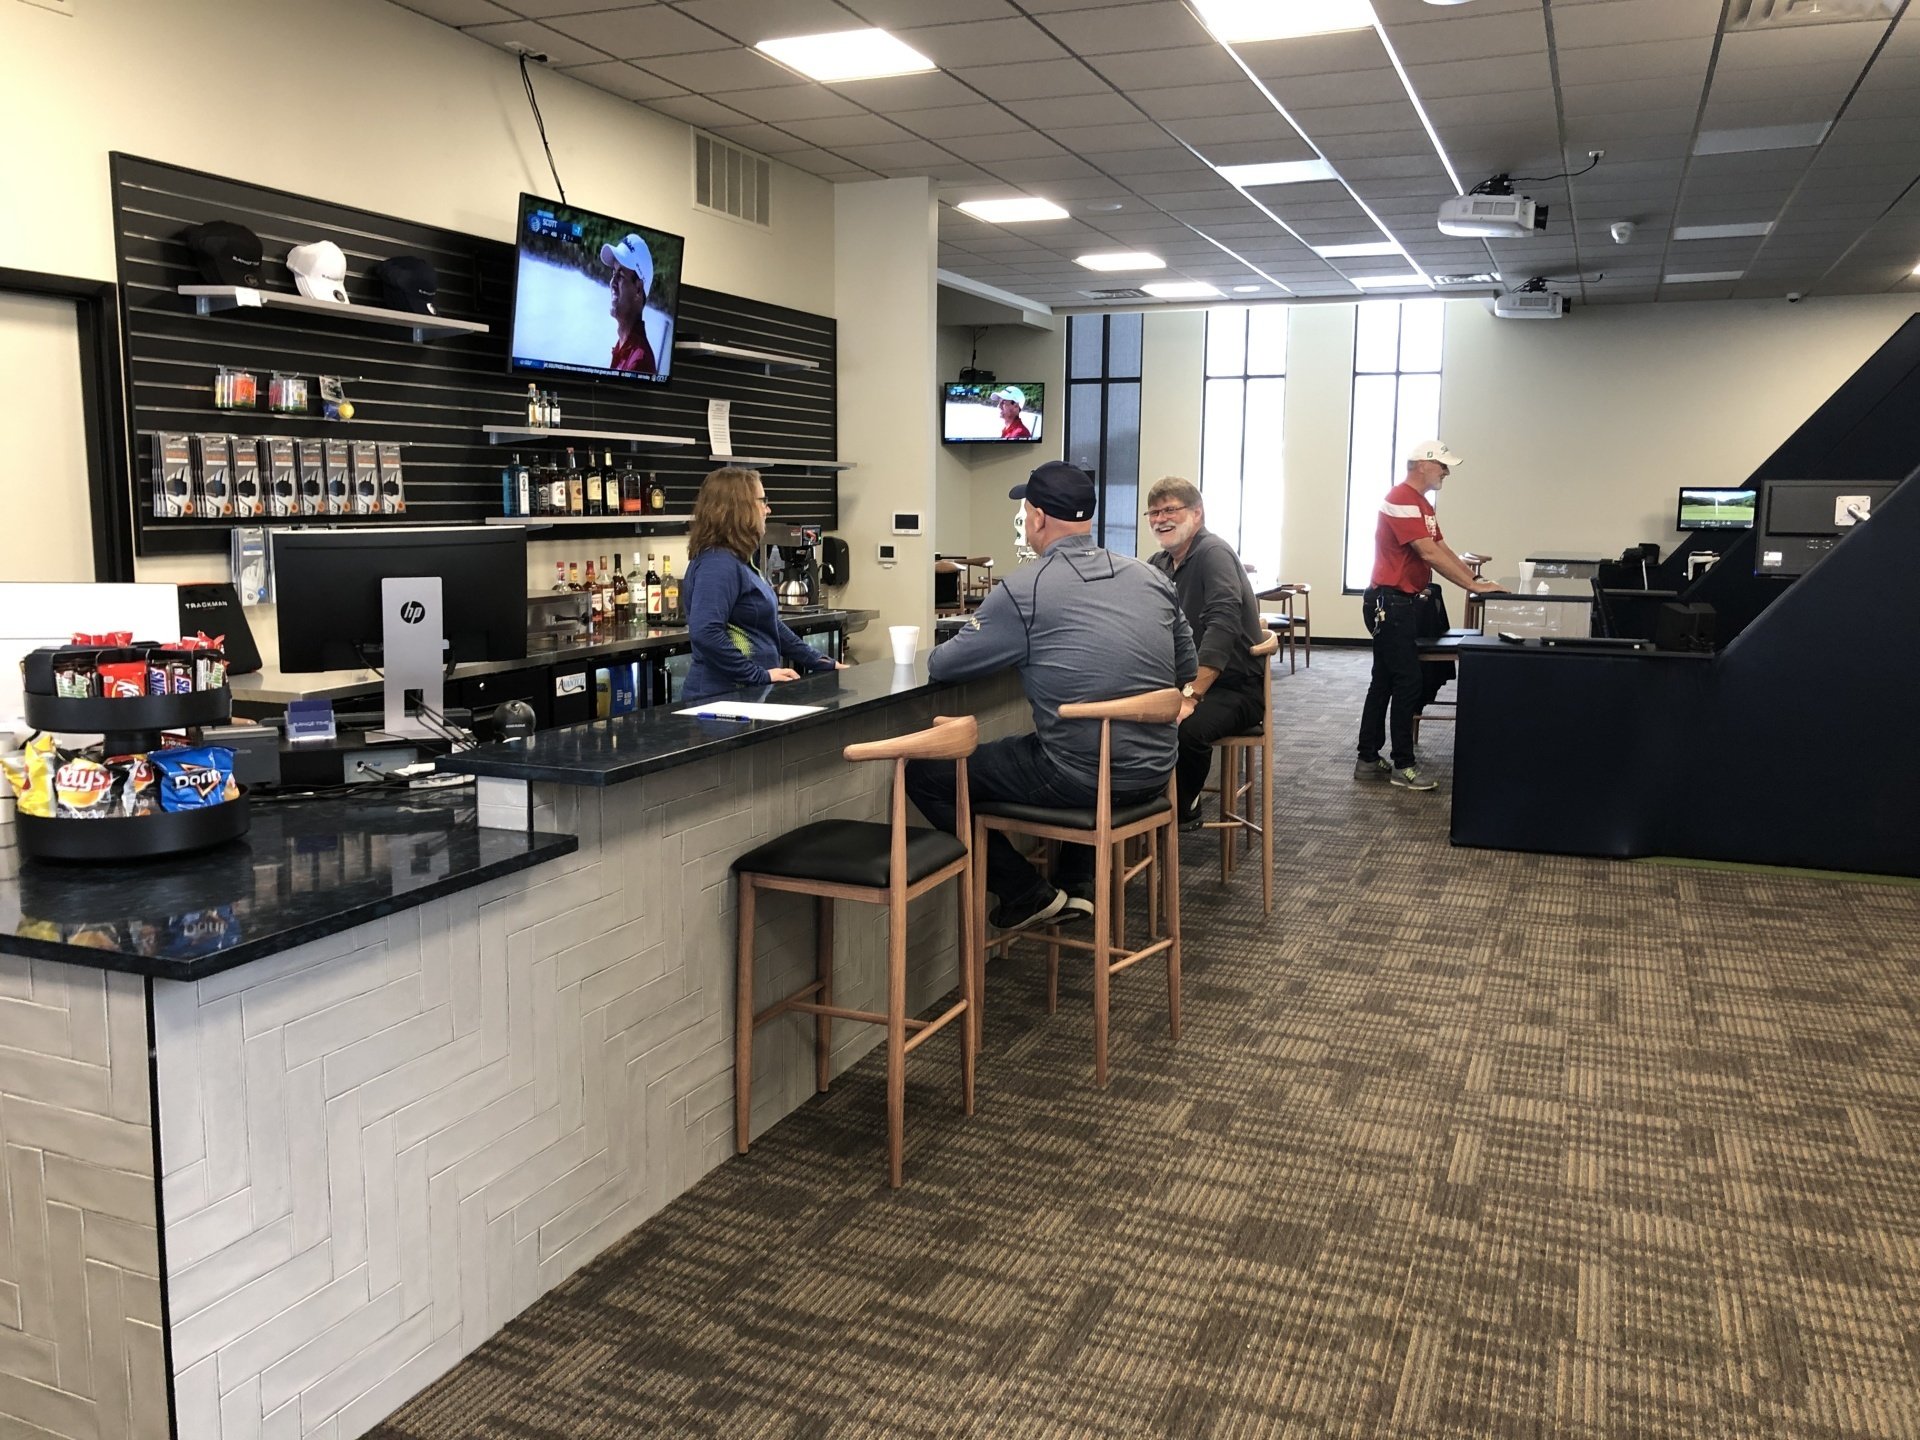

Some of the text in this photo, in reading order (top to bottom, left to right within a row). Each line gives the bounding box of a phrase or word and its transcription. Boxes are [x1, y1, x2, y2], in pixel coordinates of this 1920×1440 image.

[542, 218, 558, 228] SCOTT
[185, 601, 228, 609] TRACKMAN
[403, 601, 423, 624] hp
